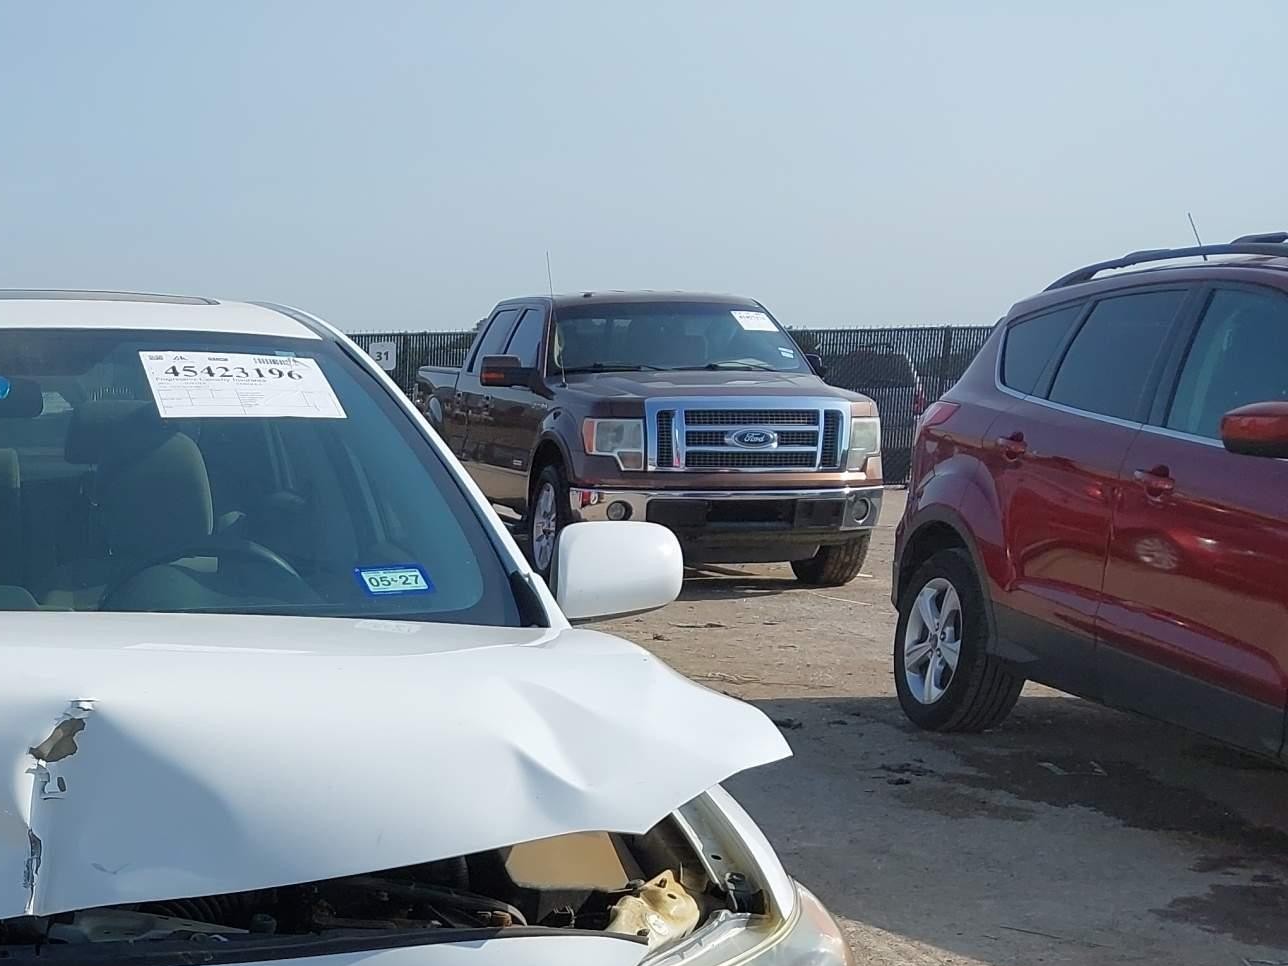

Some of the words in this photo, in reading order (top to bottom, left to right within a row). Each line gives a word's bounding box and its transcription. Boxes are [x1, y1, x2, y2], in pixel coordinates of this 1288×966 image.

[375, 351, 389, 361] 31
[164, 365, 303, 380] 45423196
[743, 432, 766, 442] Ford
